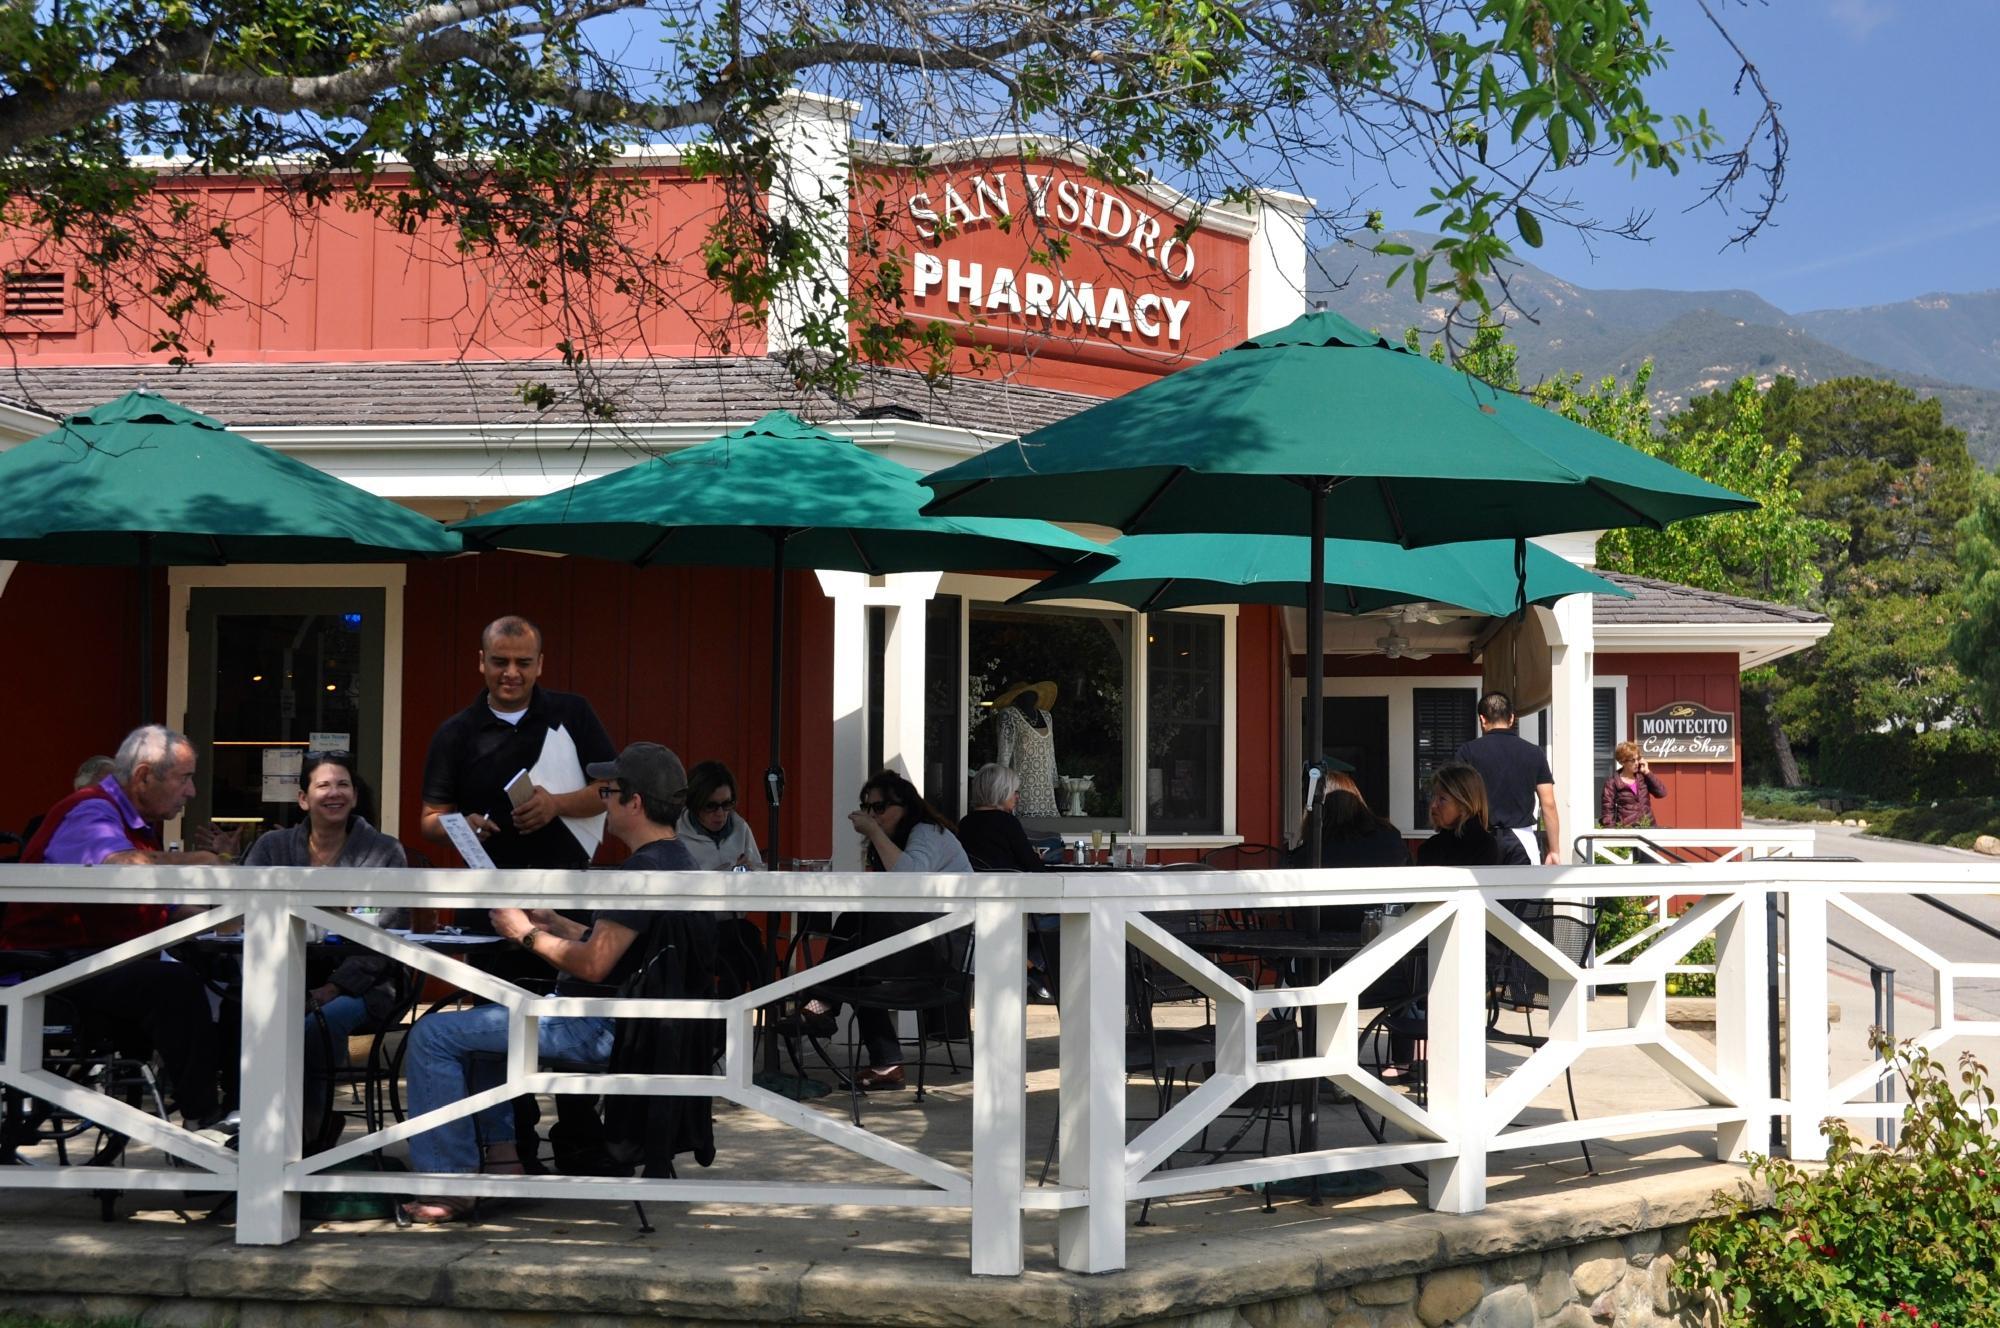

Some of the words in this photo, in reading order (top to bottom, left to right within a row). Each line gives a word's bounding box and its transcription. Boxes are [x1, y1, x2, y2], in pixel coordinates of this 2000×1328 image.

[909, 172, 1011, 238] SAN
[1021, 174, 1195, 282] YSIDRO
[913, 252, 1191, 340] PHARMACY
[1643, 718, 1728, 734] MONTECITO
[1643, 736, 1686, 757] Coffee
[1689, 735, 1728, 757] Shop
